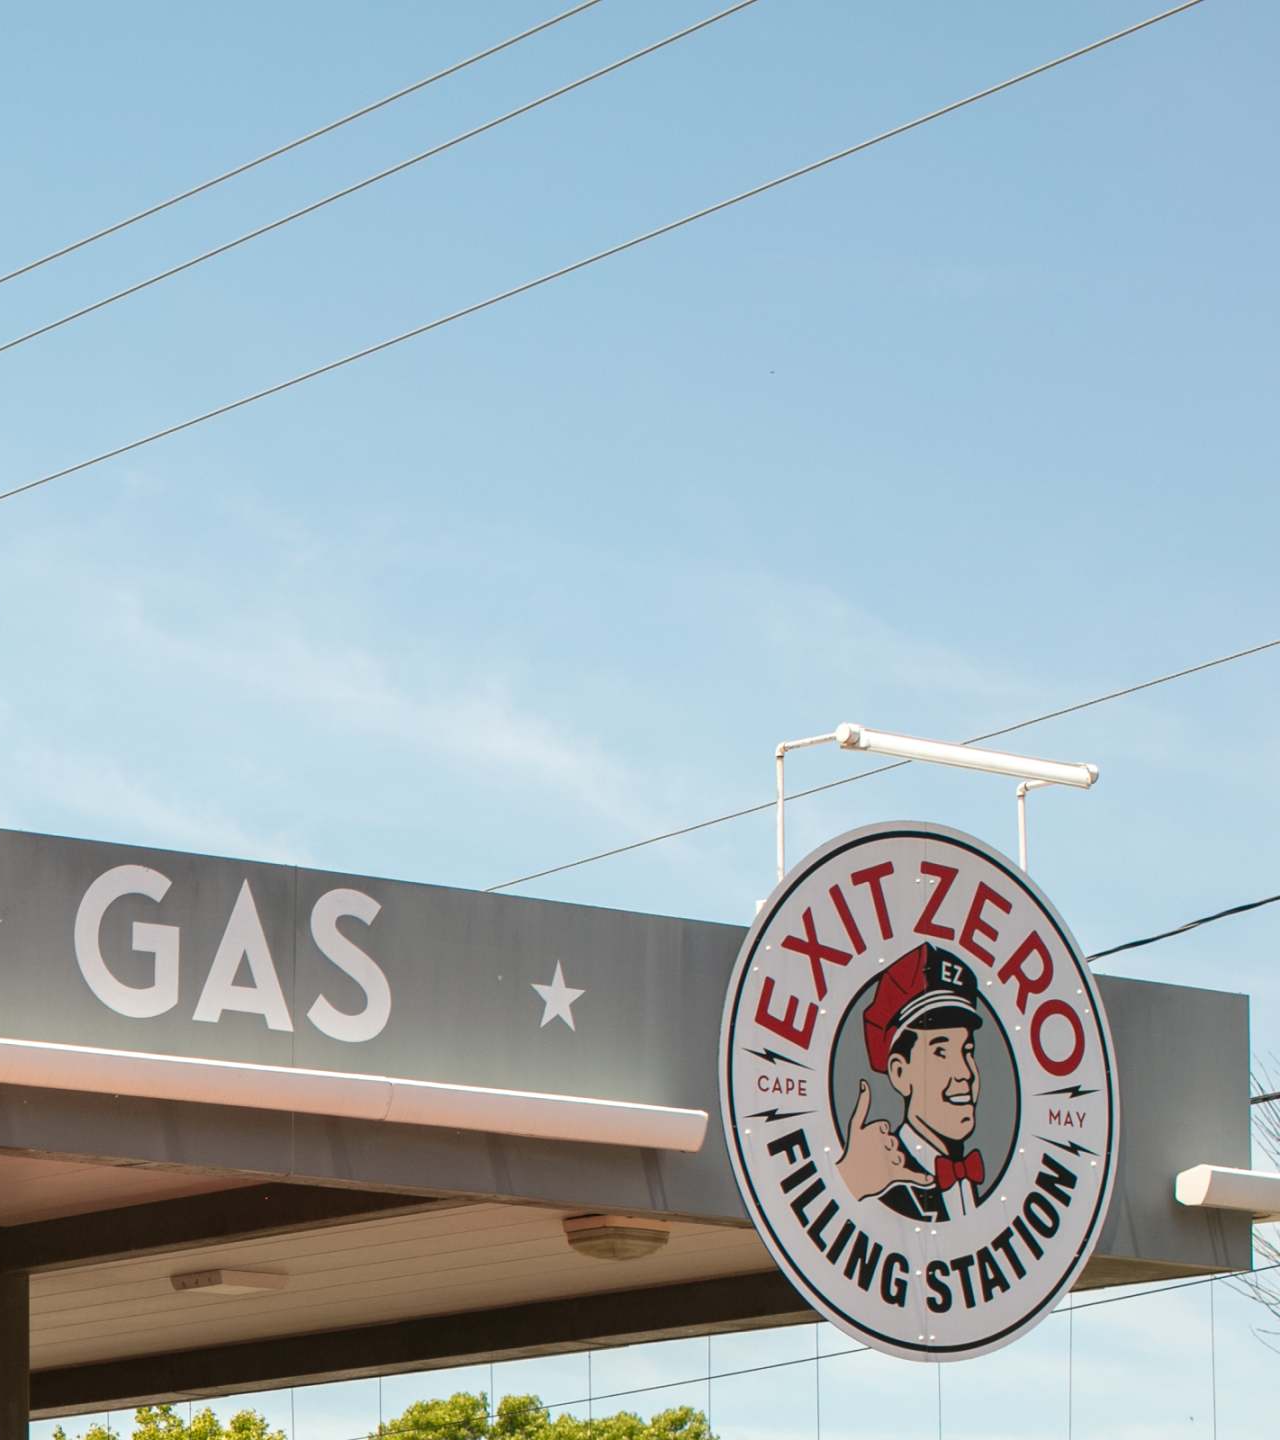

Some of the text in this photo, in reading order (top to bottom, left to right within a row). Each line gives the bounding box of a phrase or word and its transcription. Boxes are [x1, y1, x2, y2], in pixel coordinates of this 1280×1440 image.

[73, 863, 393, 1044] GAS
[754, 860, 1086, 1077] EXIT ZERO
[940, 961, 965, 987] EZ
[756, 1074, 808, 1097] CAPE
[1048, 1108, 1088, 1129] MAY
[767, 1127, 1080, 1315] FILLING STATION
